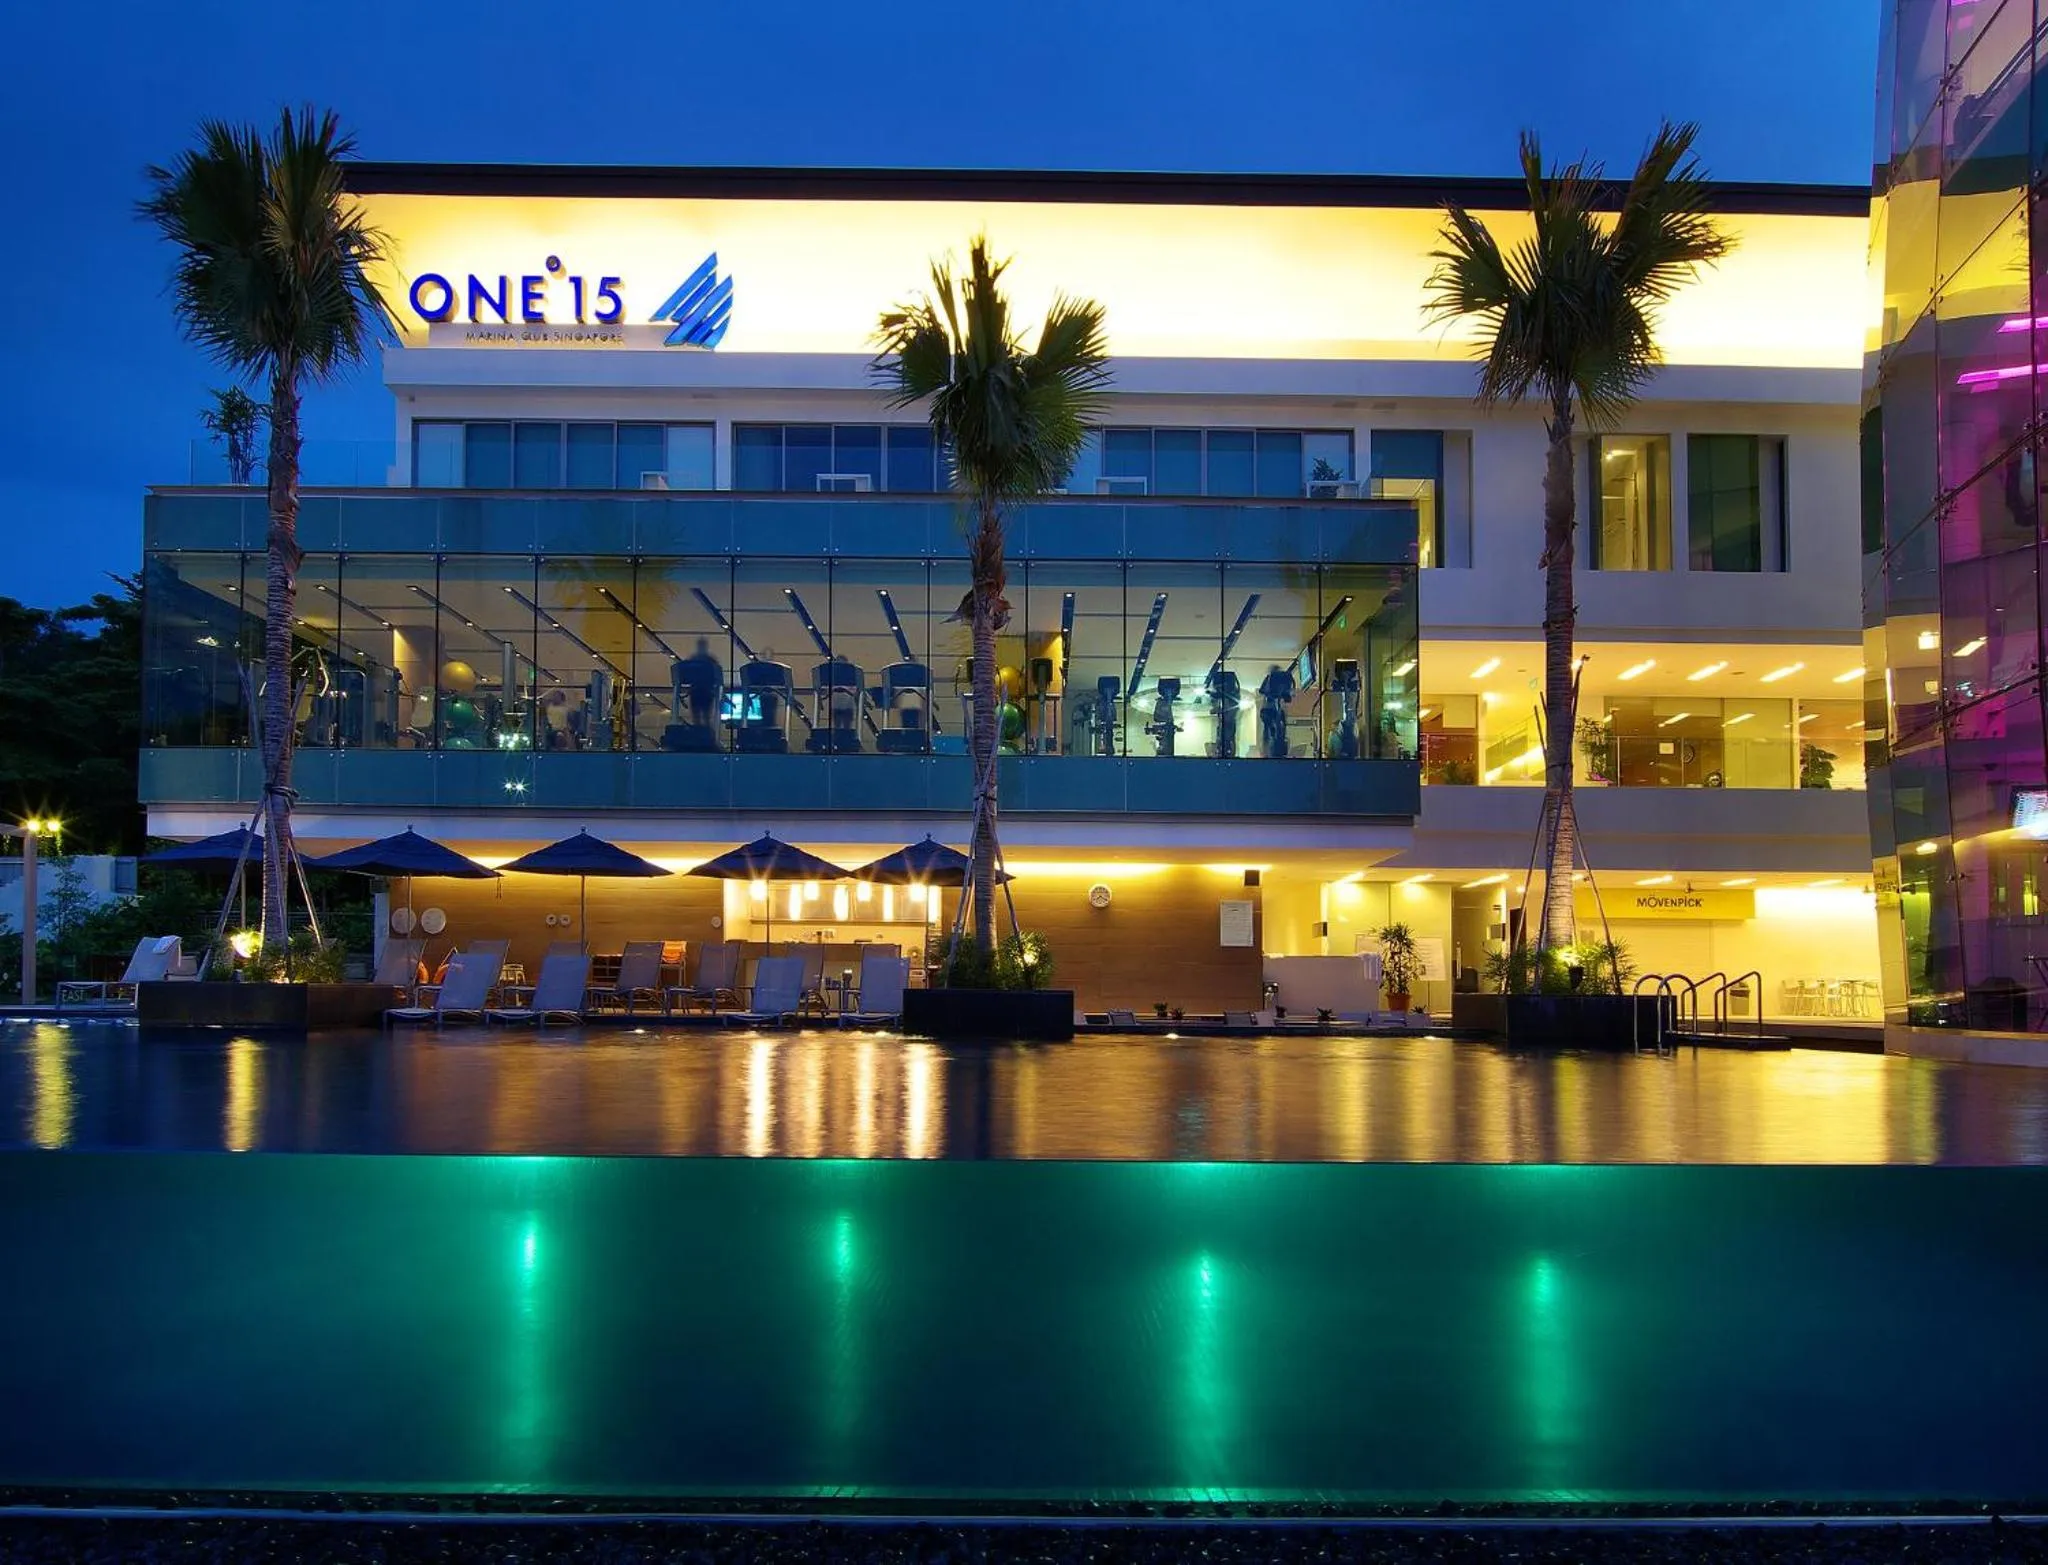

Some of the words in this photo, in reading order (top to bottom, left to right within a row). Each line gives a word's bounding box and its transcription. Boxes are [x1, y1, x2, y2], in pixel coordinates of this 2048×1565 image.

[465, 331, 515, 343] MARINA
[520, 331, 549, 343] CLUB
[553, 331, 625, 343] SINGAPORE
